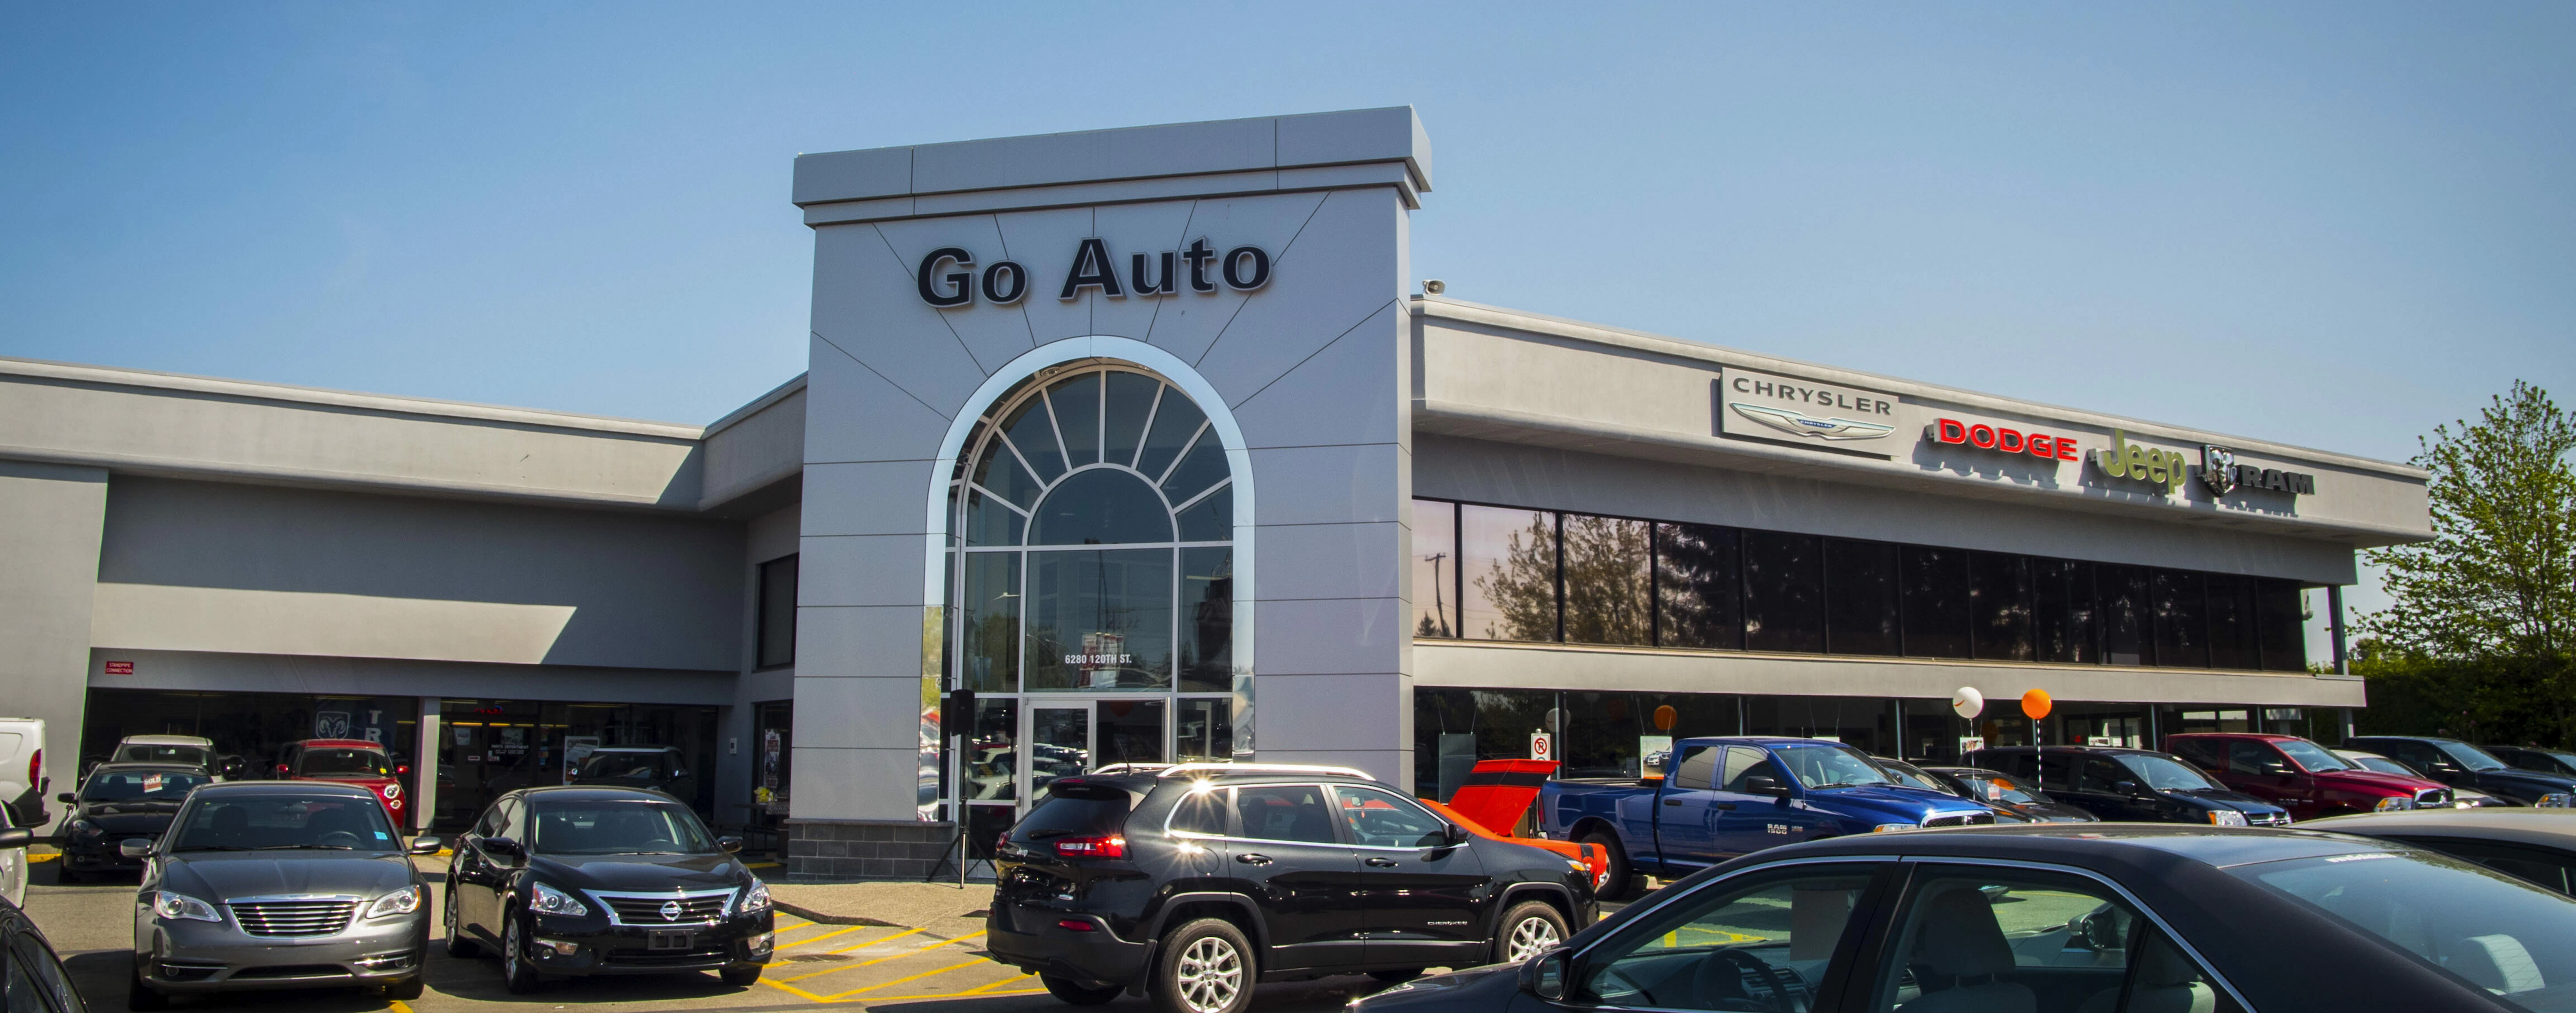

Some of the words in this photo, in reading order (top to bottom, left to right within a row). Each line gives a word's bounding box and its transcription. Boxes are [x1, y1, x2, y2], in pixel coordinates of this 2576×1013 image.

[917, 246, 1029, 307] Go
[1058, 236, 1272, 302] Auto
[1733, 378, 1890, 415] CHRYSLER
[1936, 418, 2078, 461] DODGE
[2102, 428, 2186, 494] Jeep
[2240, 464, 2314, 495] RAM
[1065, 655, 1087, 663] 6280
[1090, 654, 1117, 663] 120TH
[1120, 654, 1132, 663] ST.
[144, 777, 161, 785] SOLD
